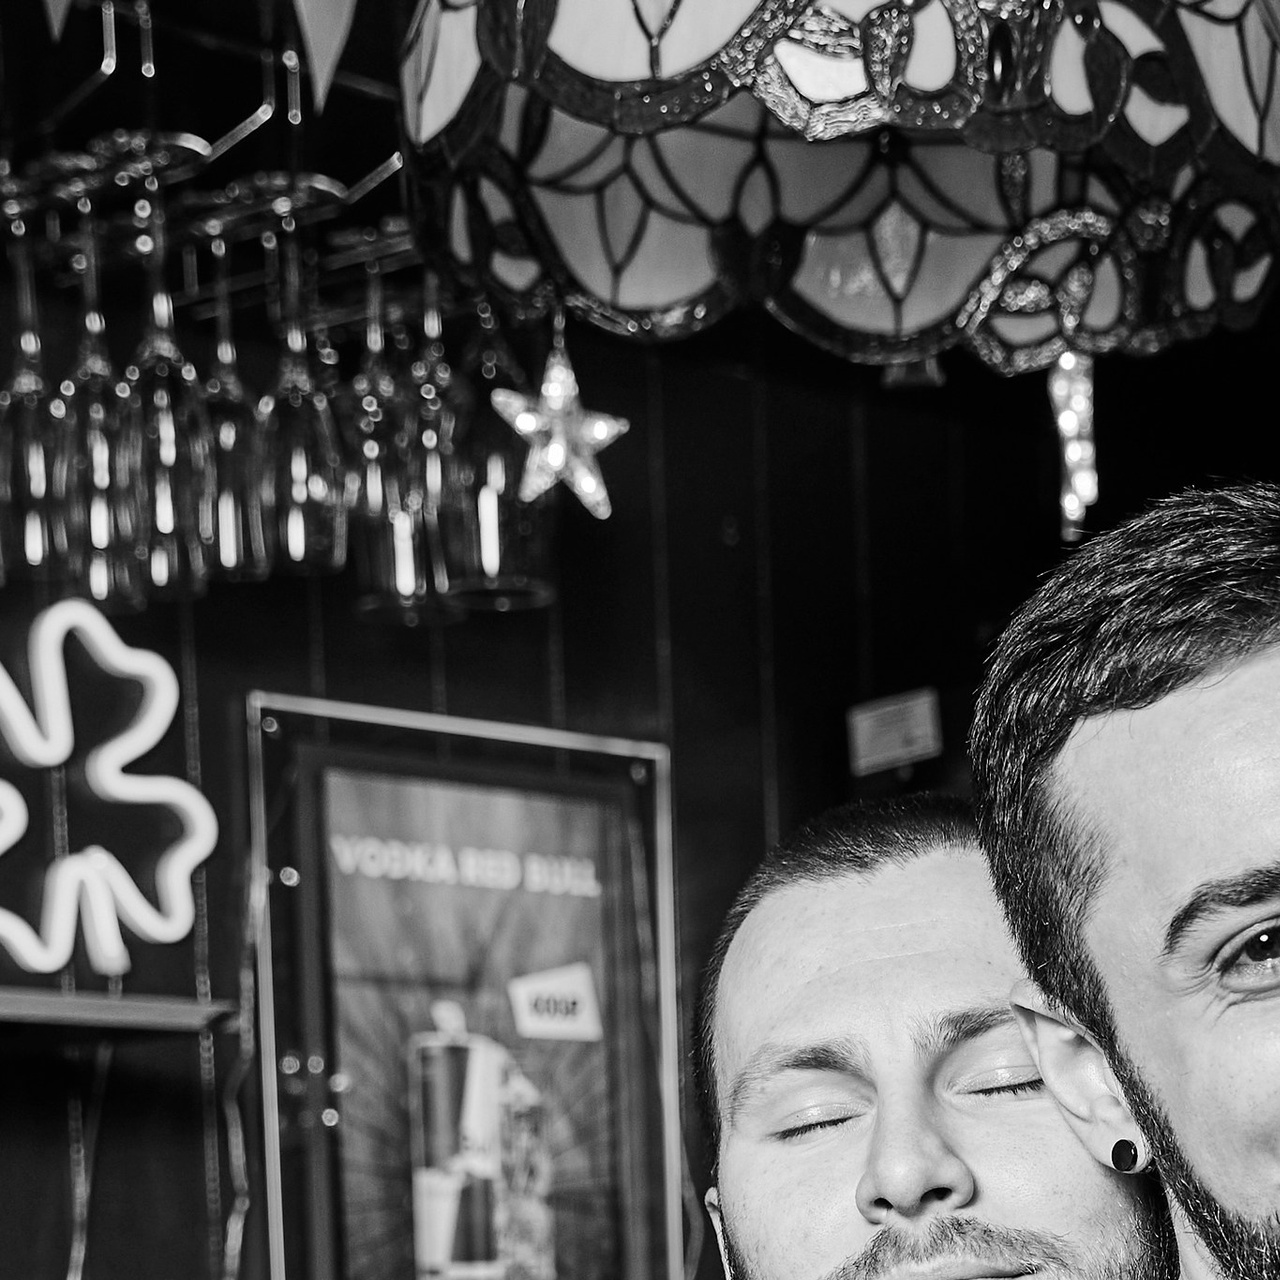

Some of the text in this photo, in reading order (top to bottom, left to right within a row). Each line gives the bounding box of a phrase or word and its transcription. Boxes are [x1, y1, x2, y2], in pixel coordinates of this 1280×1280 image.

[330, 834, 602, 897] VODKA RED BULL
